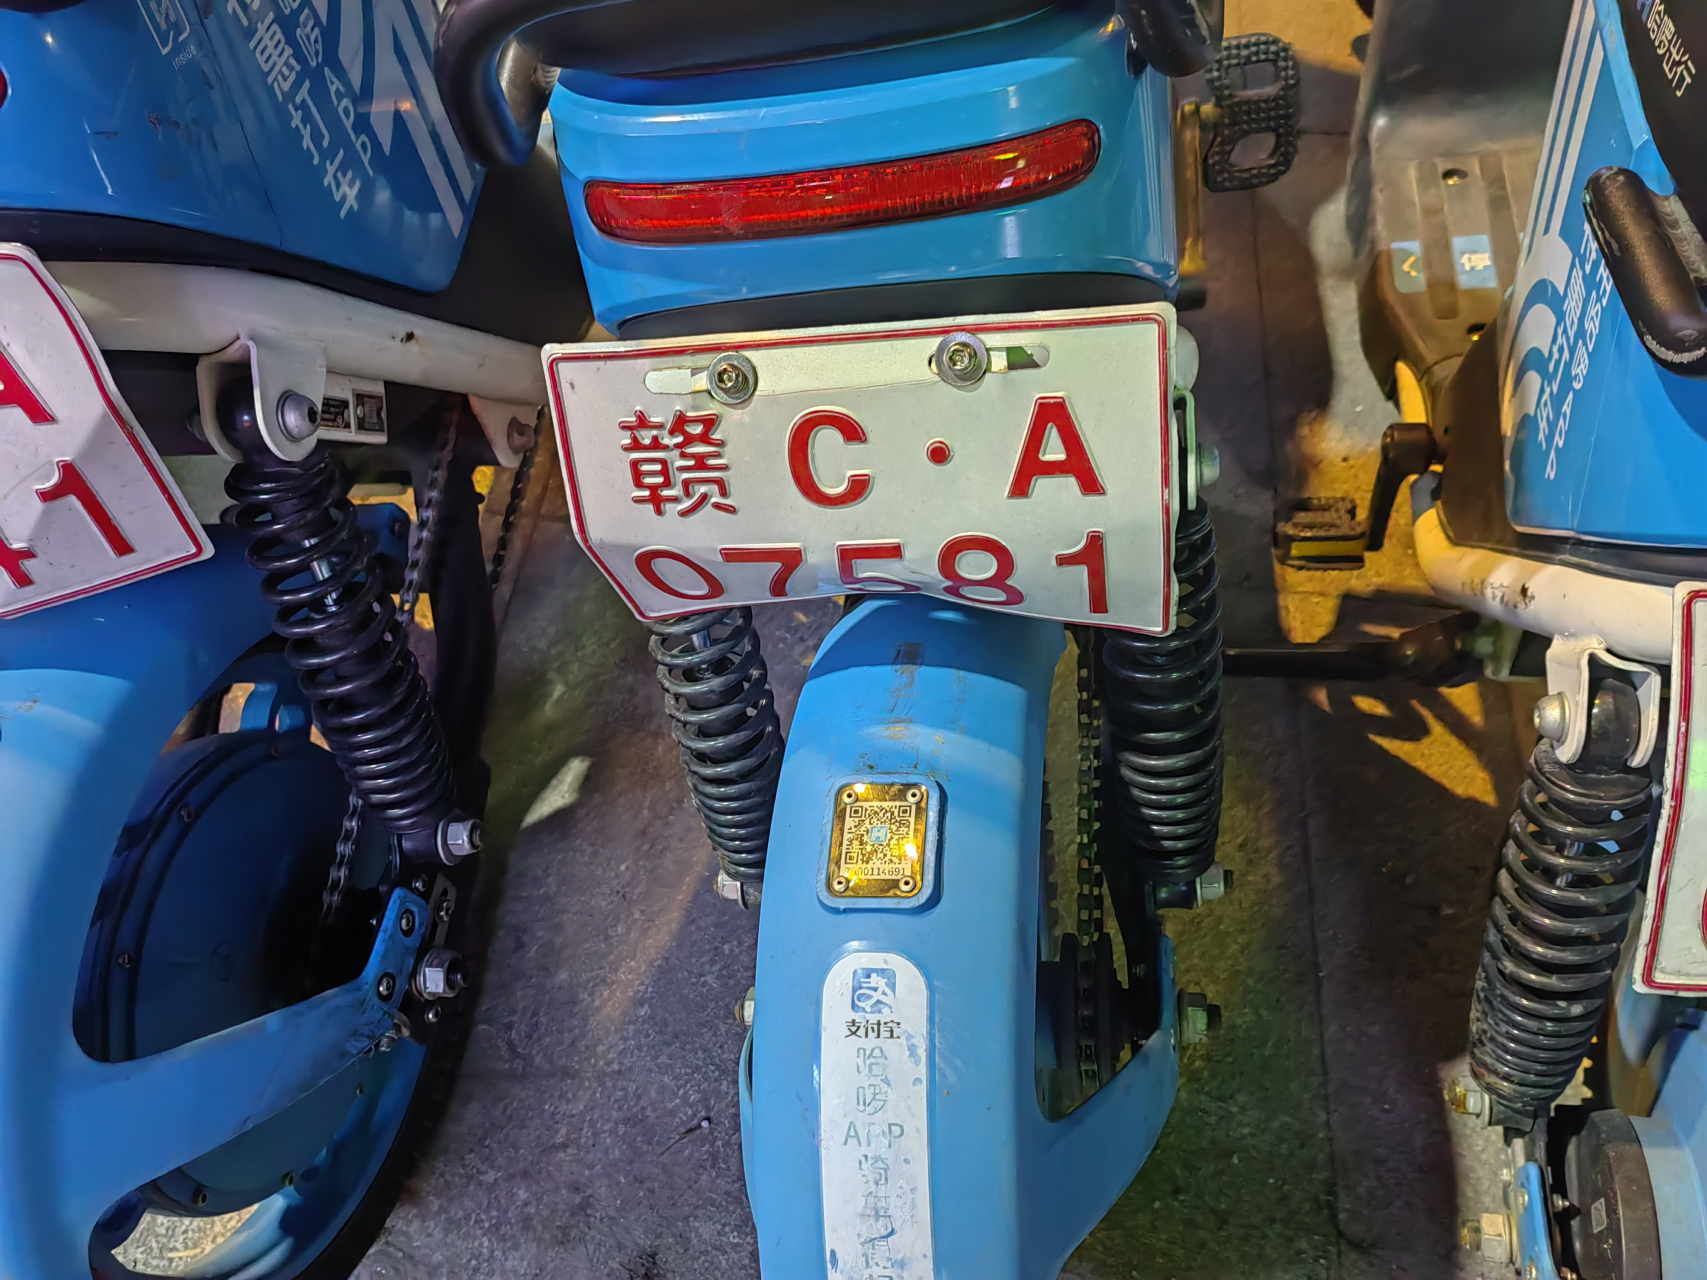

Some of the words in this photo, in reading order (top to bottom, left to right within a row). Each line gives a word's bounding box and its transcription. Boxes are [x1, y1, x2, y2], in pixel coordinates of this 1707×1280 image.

[634, 530, 1109, 614] 07581
[844, 1018, 902, 1040] 支付宝
